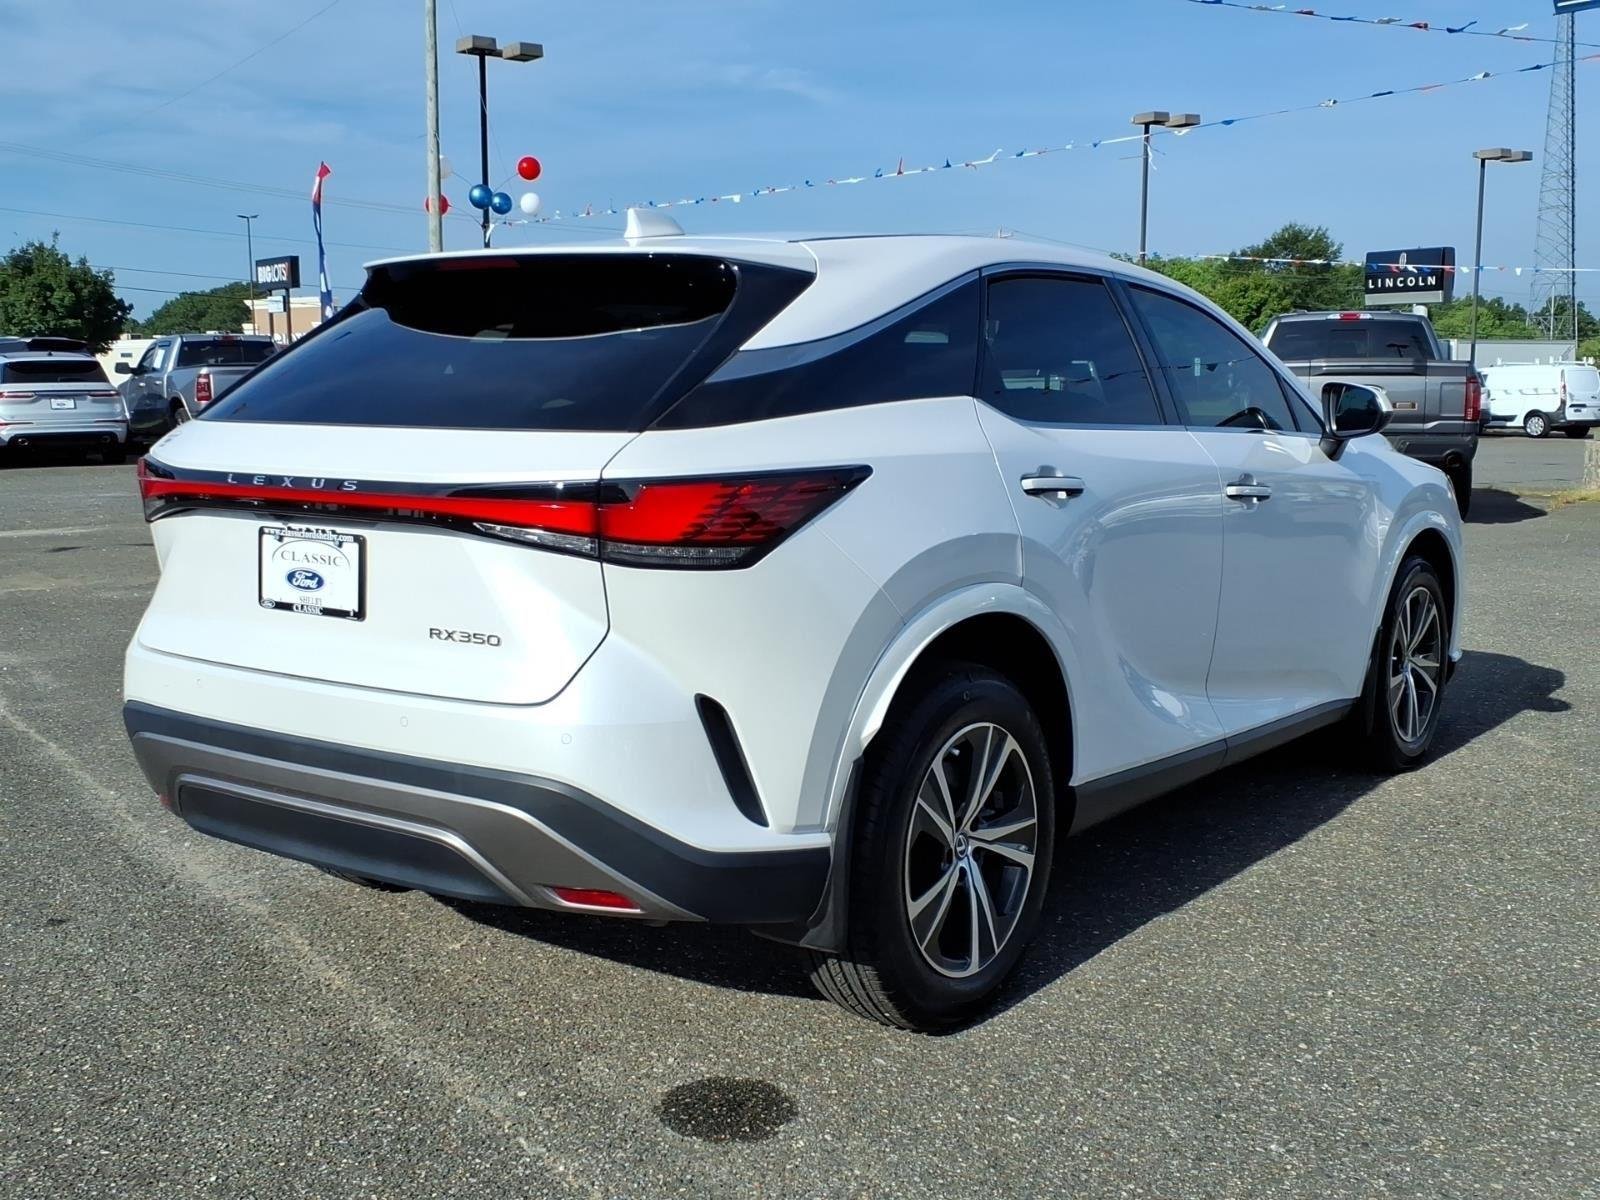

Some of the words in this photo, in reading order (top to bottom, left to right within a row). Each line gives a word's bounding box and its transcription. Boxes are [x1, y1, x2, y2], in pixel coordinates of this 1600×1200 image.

[1368, 276, 1436, 289] LINCOLN
[227, 473, 358, 491] LEXUS
[281, 550, 342, 567] CLASSIC
[293, 570, 319, 588] Ford
[293, 604, 323, 615] CLASSIC
